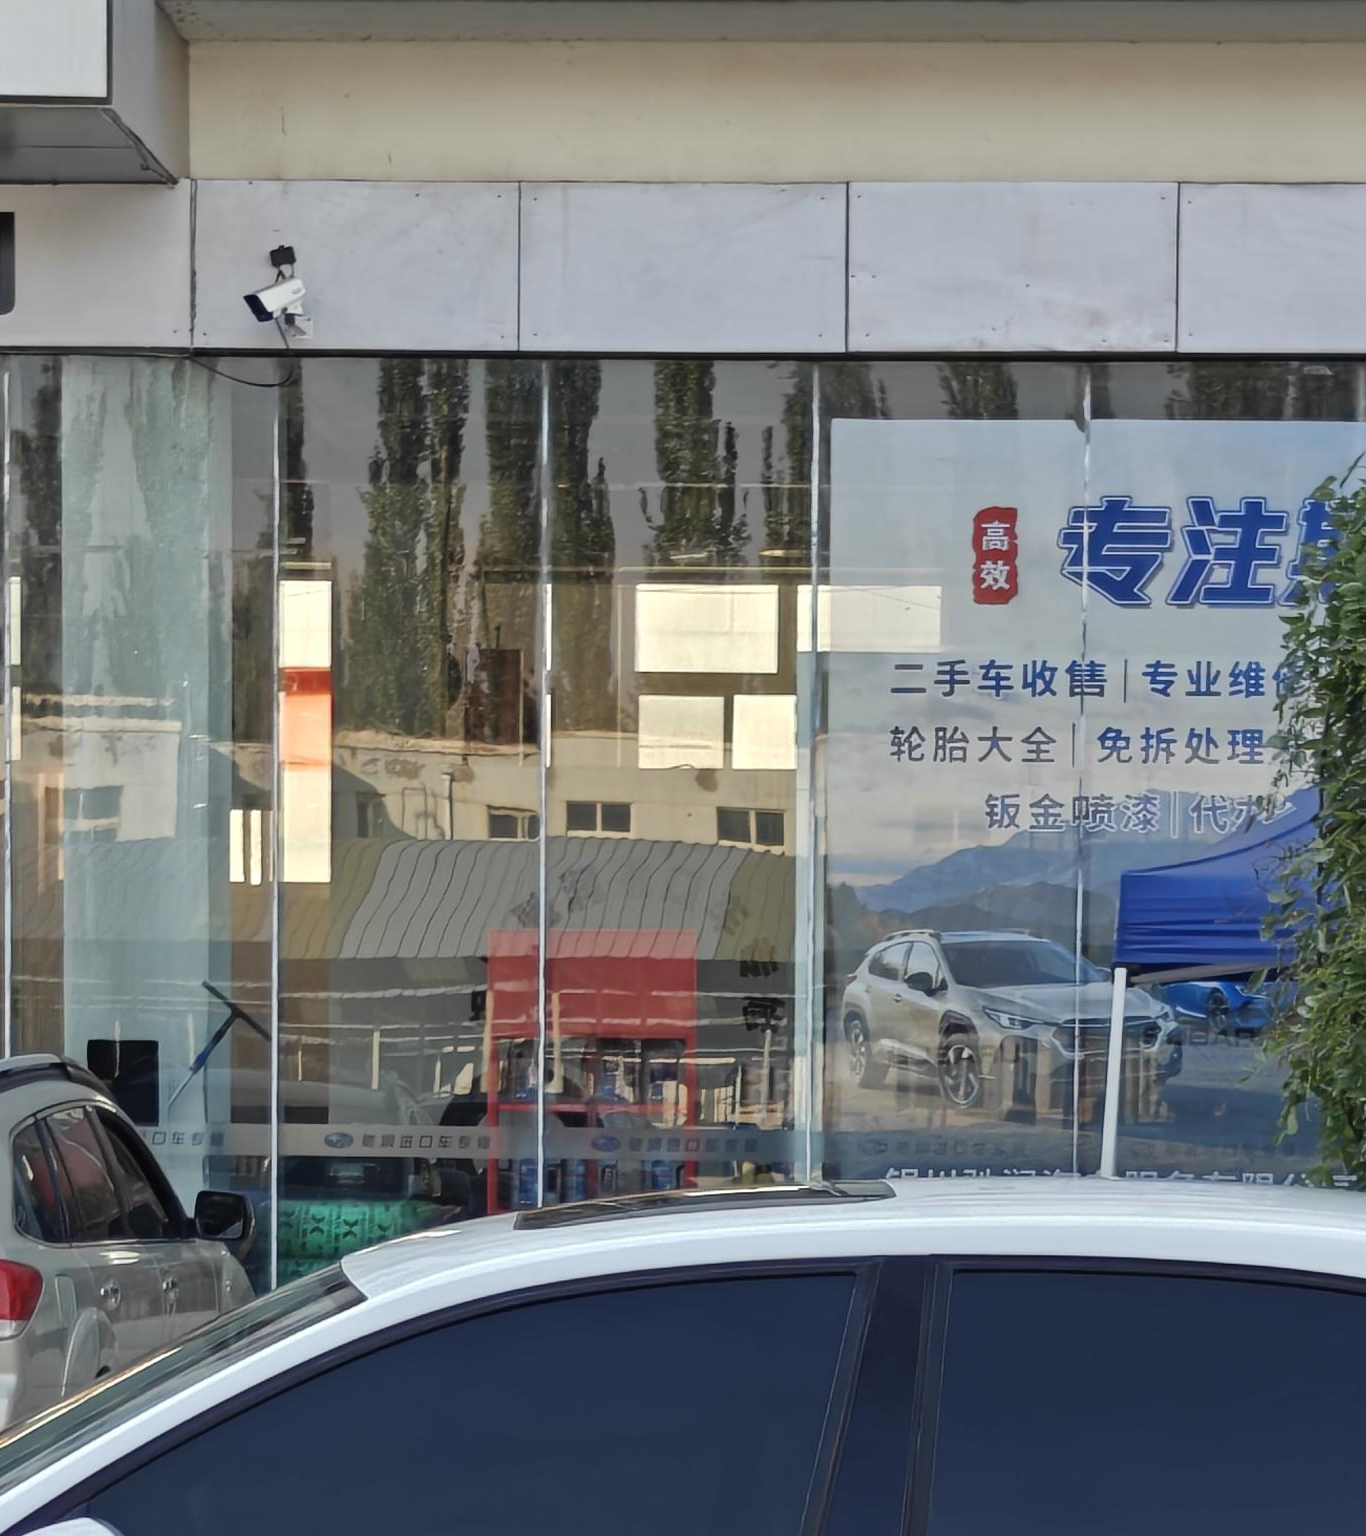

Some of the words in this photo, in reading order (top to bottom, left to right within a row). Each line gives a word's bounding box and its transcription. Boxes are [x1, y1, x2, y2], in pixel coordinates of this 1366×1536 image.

[980, 520, 1011, 590] 高效
[890, 659, 1108, 698] 二手车收售
[889, 726, 1057, 764] 轮胎大全
[1097, 726, 1266, 765] 免拆处理
[984, 793, 1160, 833] 钣金喷漆
